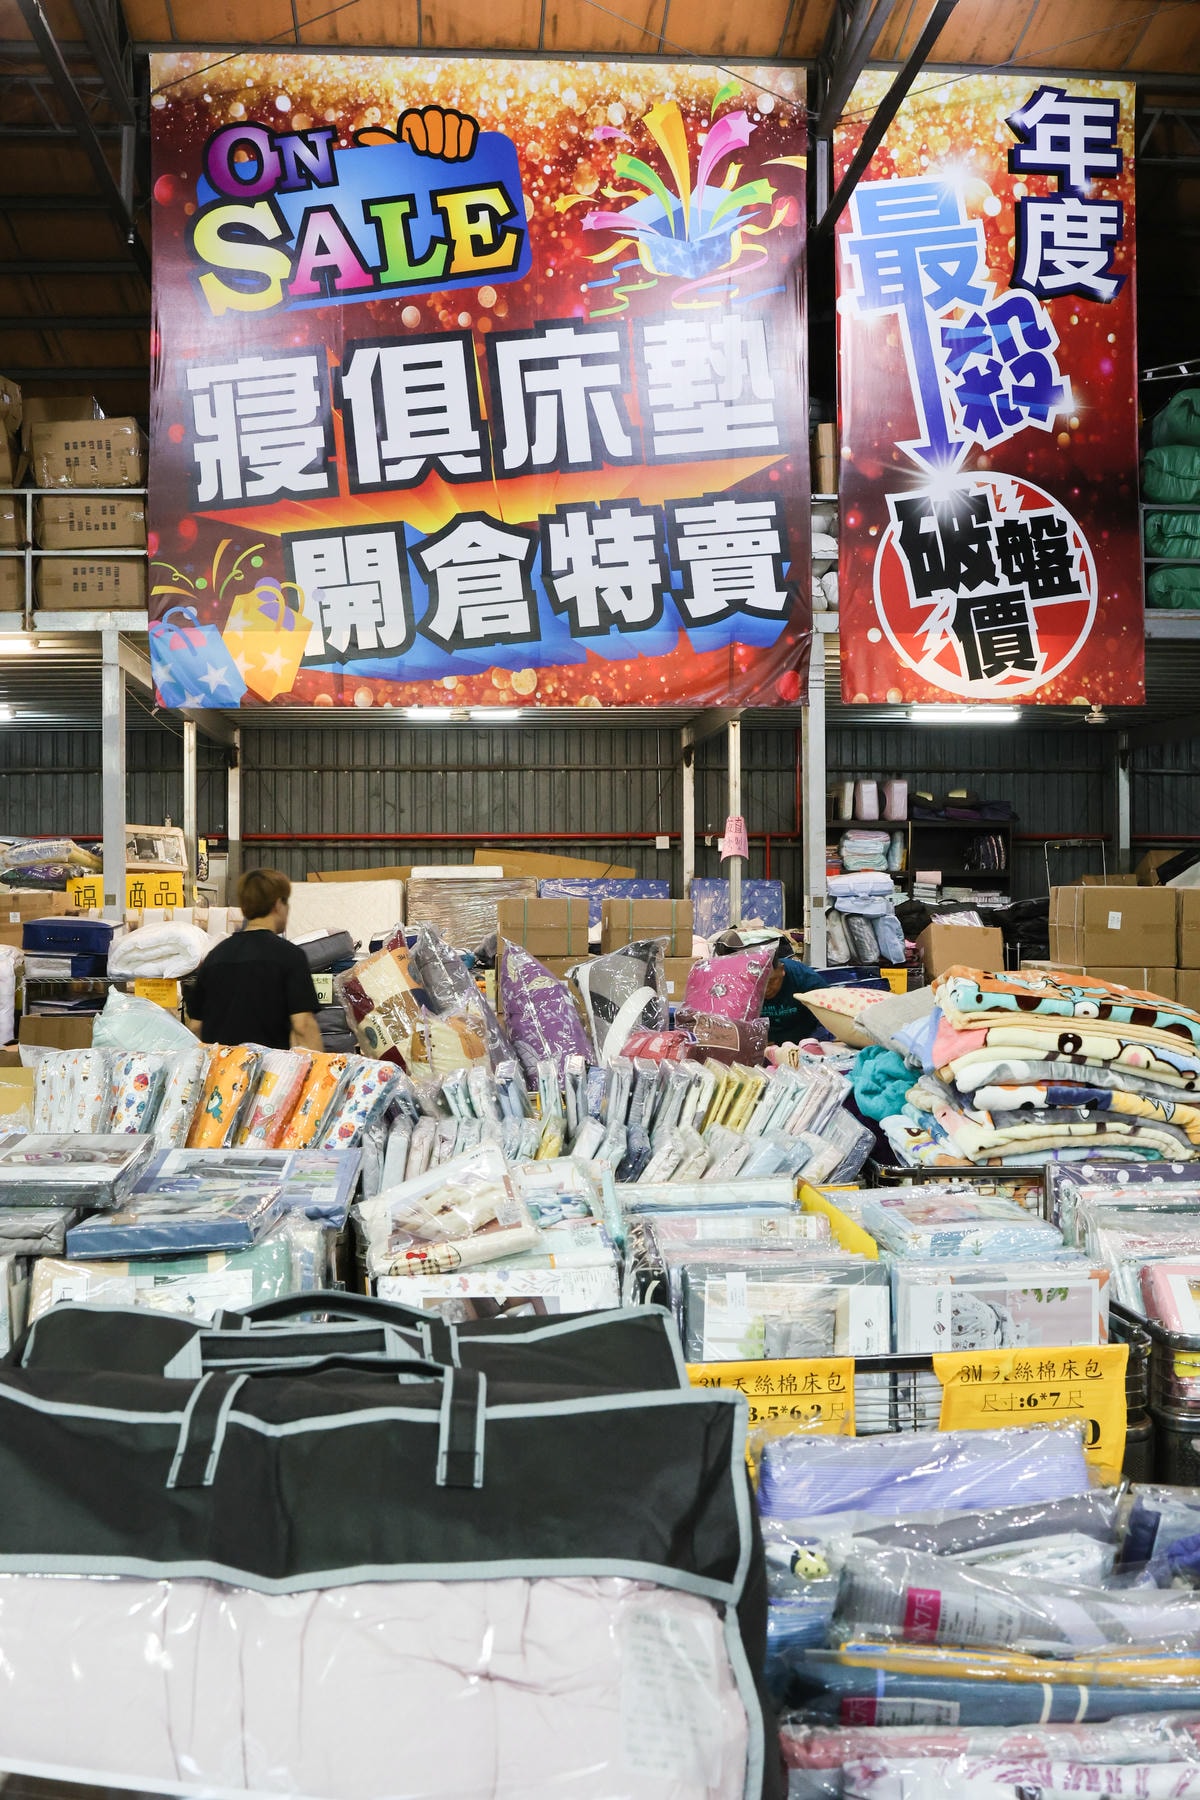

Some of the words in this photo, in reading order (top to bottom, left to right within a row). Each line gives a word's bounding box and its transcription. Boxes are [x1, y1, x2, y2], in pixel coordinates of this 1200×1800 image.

[206, 124, 335, 197] ON
[1017, 90, 1122, 298] 年度
[193, 187, 520, 316] SALE
[848, 180, 1065, 441] 最殺
[186, 315, 780, 503] 寢俱床墊
[291, 500, 788, 657] 開倉特賣
[960, 1365, 982, 1383] 3M
